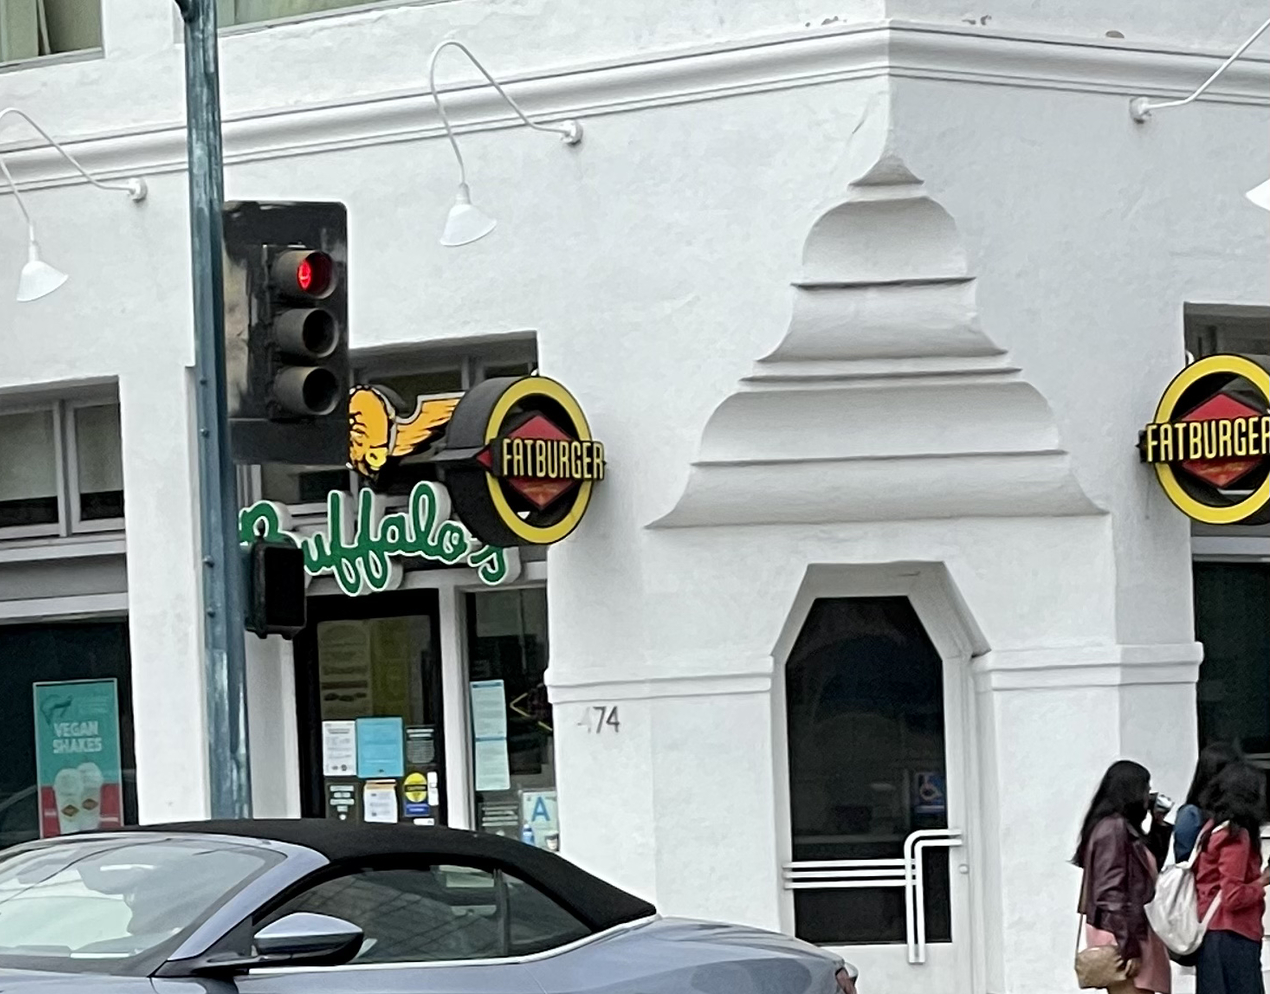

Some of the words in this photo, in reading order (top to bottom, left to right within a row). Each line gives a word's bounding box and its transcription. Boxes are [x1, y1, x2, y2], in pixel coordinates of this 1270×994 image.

[502, 438, 605, 479] FATBURGER
[54, 720, 99, 738] VEGAN
[53, 737, 102, 754] SHAKES
[531, 796, 550, 822] A
